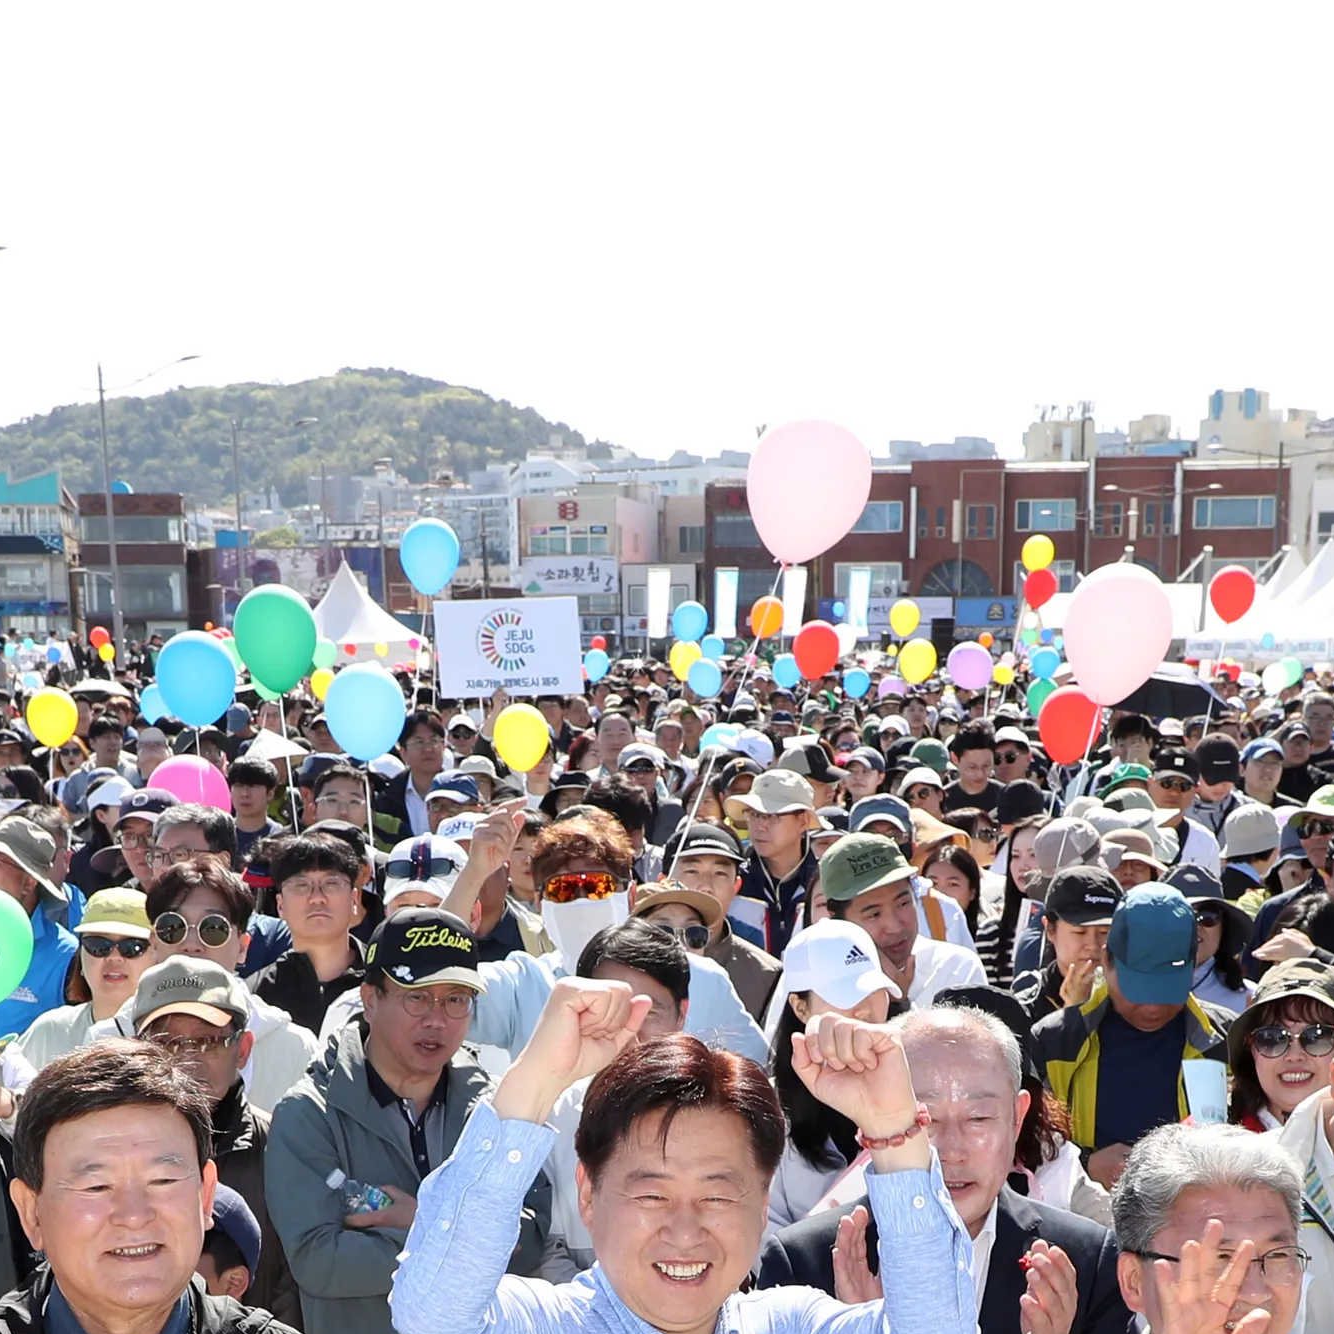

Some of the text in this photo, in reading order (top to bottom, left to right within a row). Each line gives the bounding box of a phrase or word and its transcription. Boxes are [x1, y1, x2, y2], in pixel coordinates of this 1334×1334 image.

[504, 629, 533, 641] JEJU
[504, 642, 535, 654] SDGs
[1084, 894, 1115, 904] Supreme
[400, 925, 473, 953] Titleist
[843, 954, 871, 966] adidas
